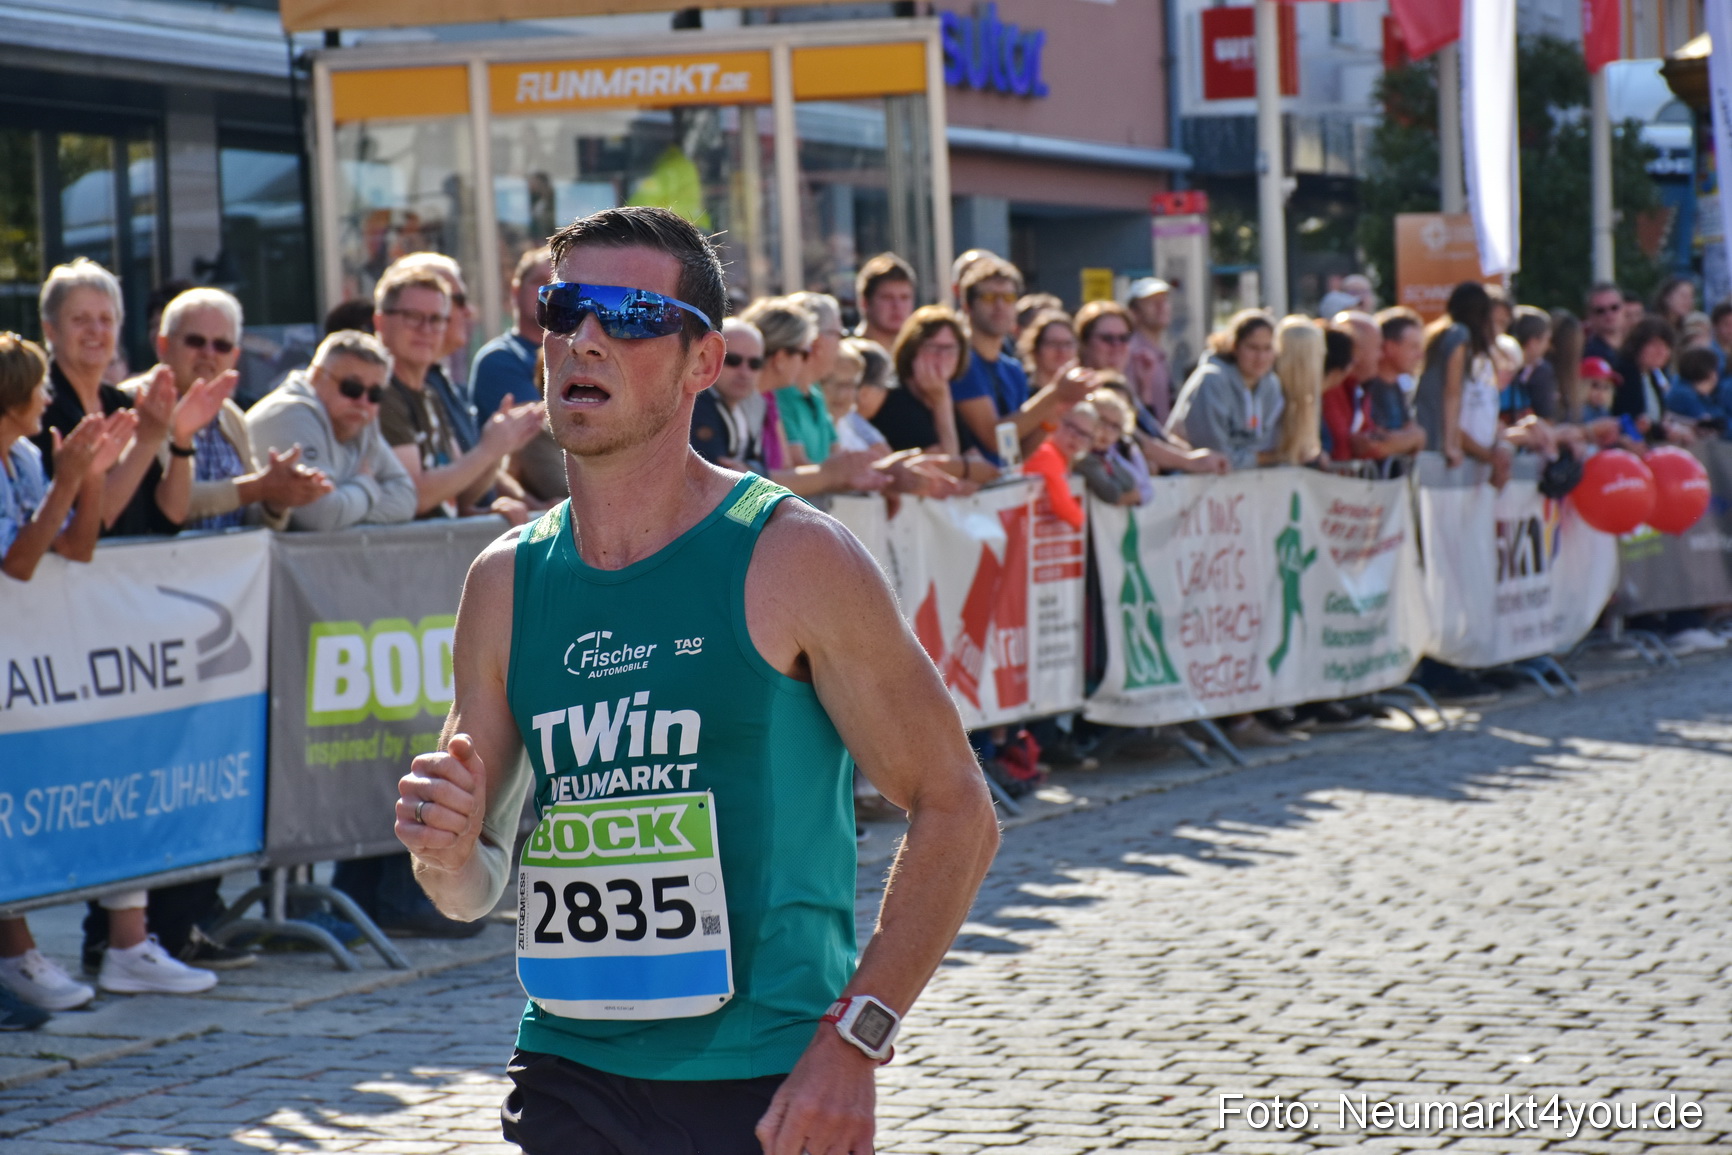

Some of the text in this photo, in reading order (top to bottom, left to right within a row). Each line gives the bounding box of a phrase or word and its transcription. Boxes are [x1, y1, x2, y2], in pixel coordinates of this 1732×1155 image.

[516, 62, 750, 102] RUNMARKT.DE
[0, 639, 185, 711] AIL.ONE
[581, 643, 657, 668] Fischer
[588, 661, 648, 679] AUTOMOBILE
[306, 732, 379, 769] inspired
[382, 731, 406, 762] by
[21, 772, 142, 837] STRECKE
[145, 752, 250, 816] ZUHAUSE
[551, 763, 697, 801] NEUMARKT
[529, 807, 692, 858] BOCK
[533, 875, 696, 943] 2835
